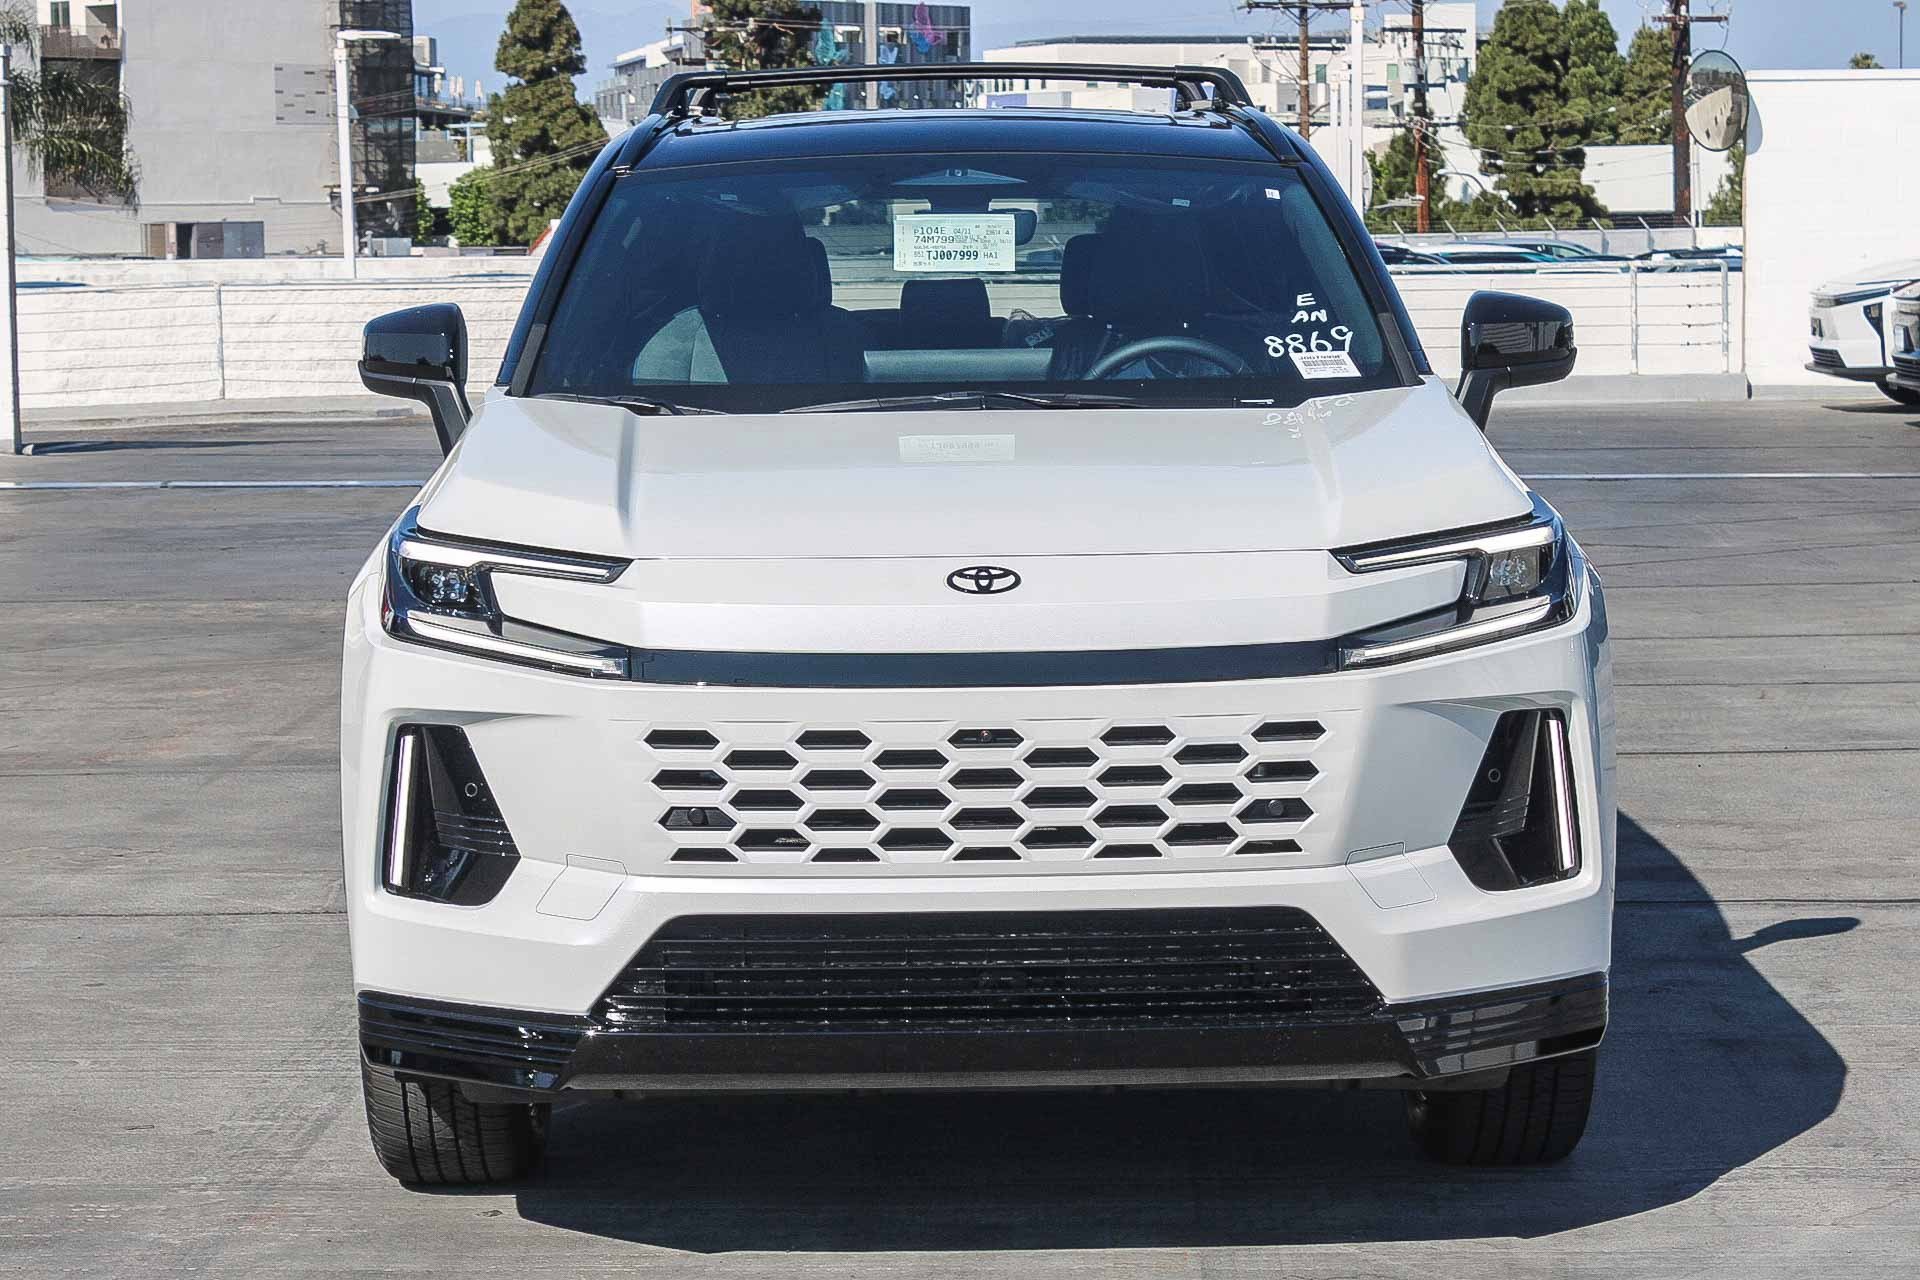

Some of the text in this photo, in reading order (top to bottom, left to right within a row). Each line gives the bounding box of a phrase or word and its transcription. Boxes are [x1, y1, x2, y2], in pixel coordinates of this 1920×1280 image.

[914, 235, 955, 243] 74M799
[926, 250, 979, 260] TJ007999
[1296, 292, 1316, 307] E
[1263, 325, 1354, 357] 8869
